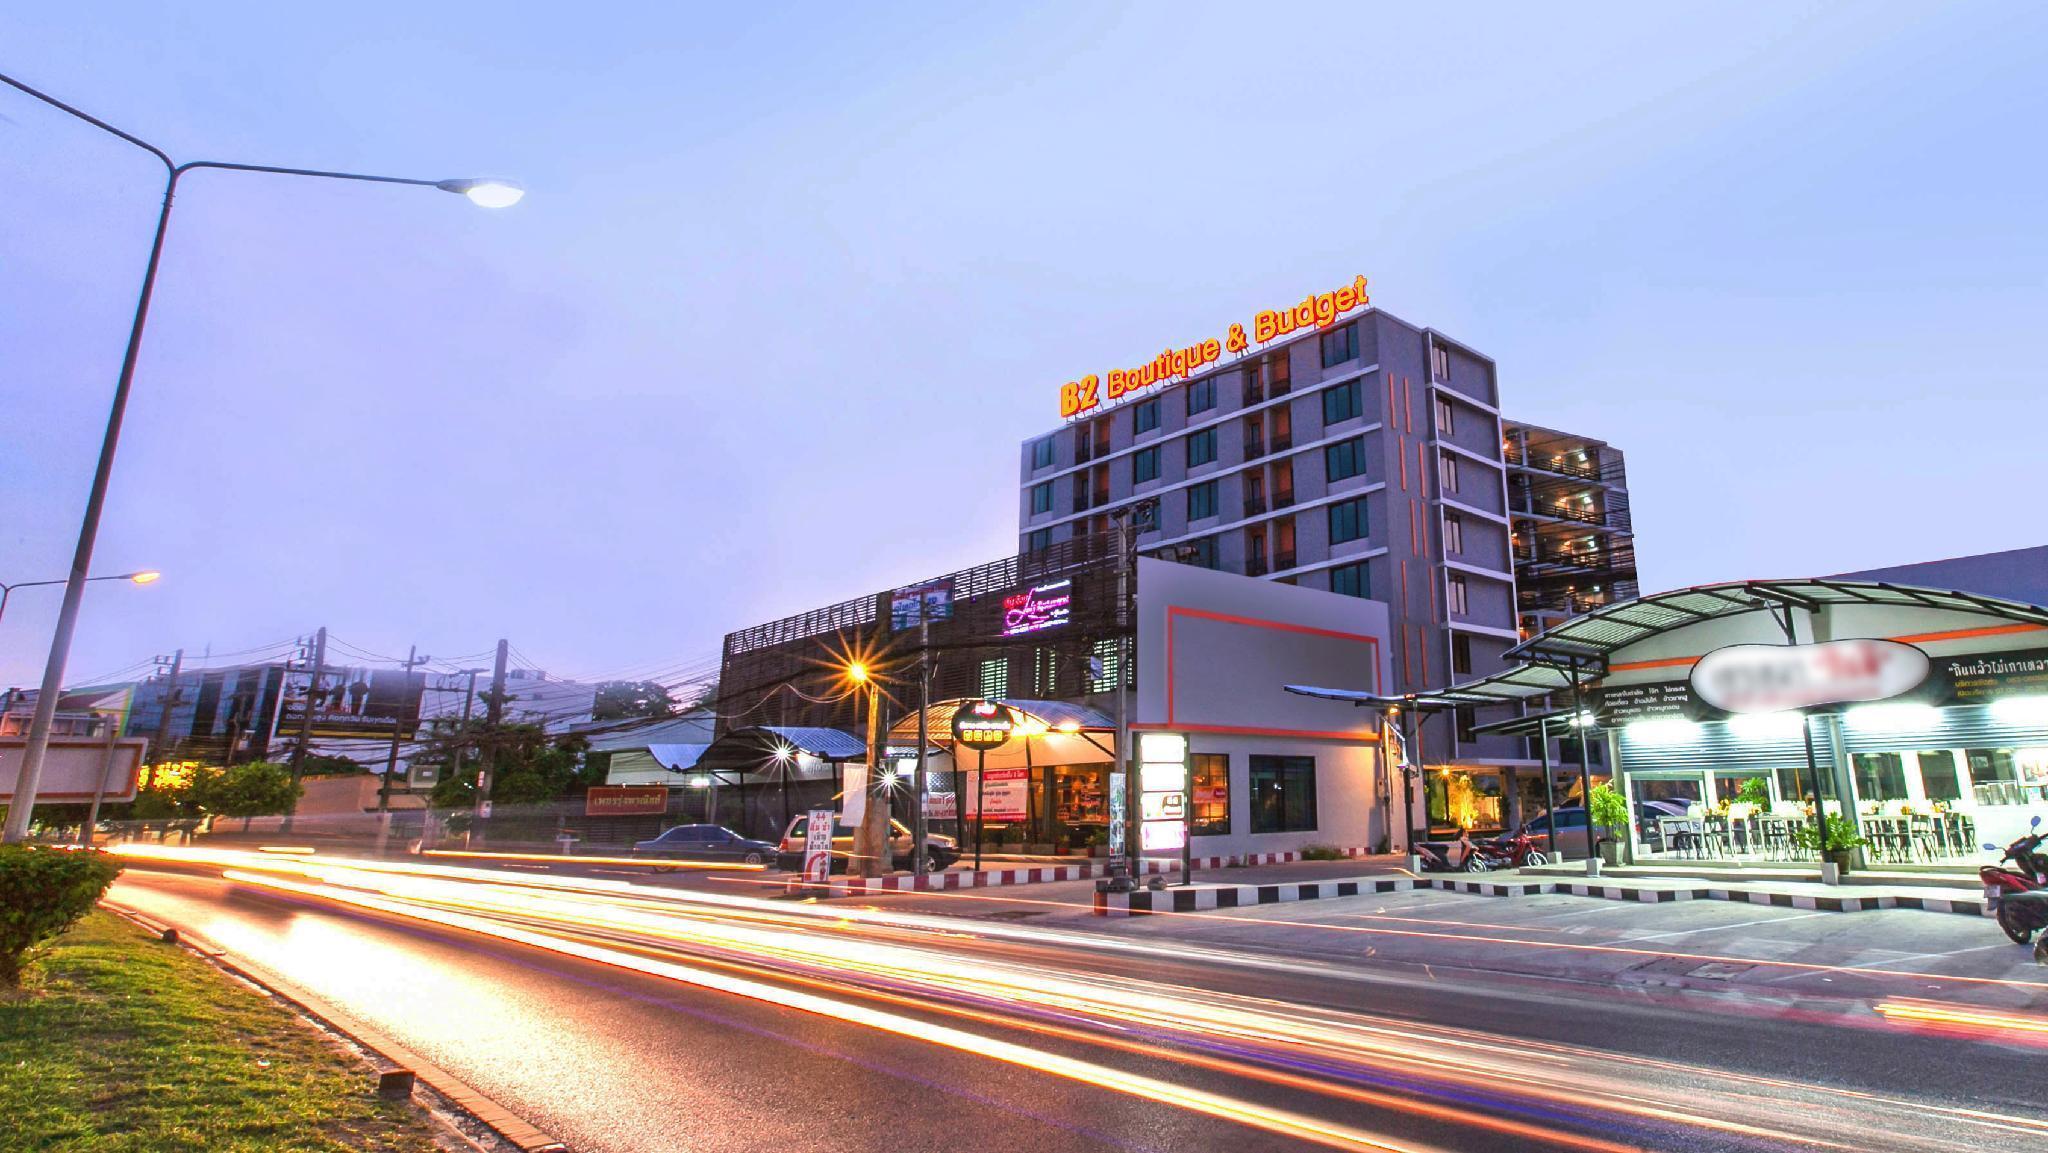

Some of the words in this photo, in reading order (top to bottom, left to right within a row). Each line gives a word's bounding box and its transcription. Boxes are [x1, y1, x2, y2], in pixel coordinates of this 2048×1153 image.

[1060, 372, 1100, 418] B2
[1107, 336, 1221, 400] Boutique
[1226, 322, 1247, 353] &
[1254, 274, 1369, 344] Budget
[816, 812, 826, 821] 44
